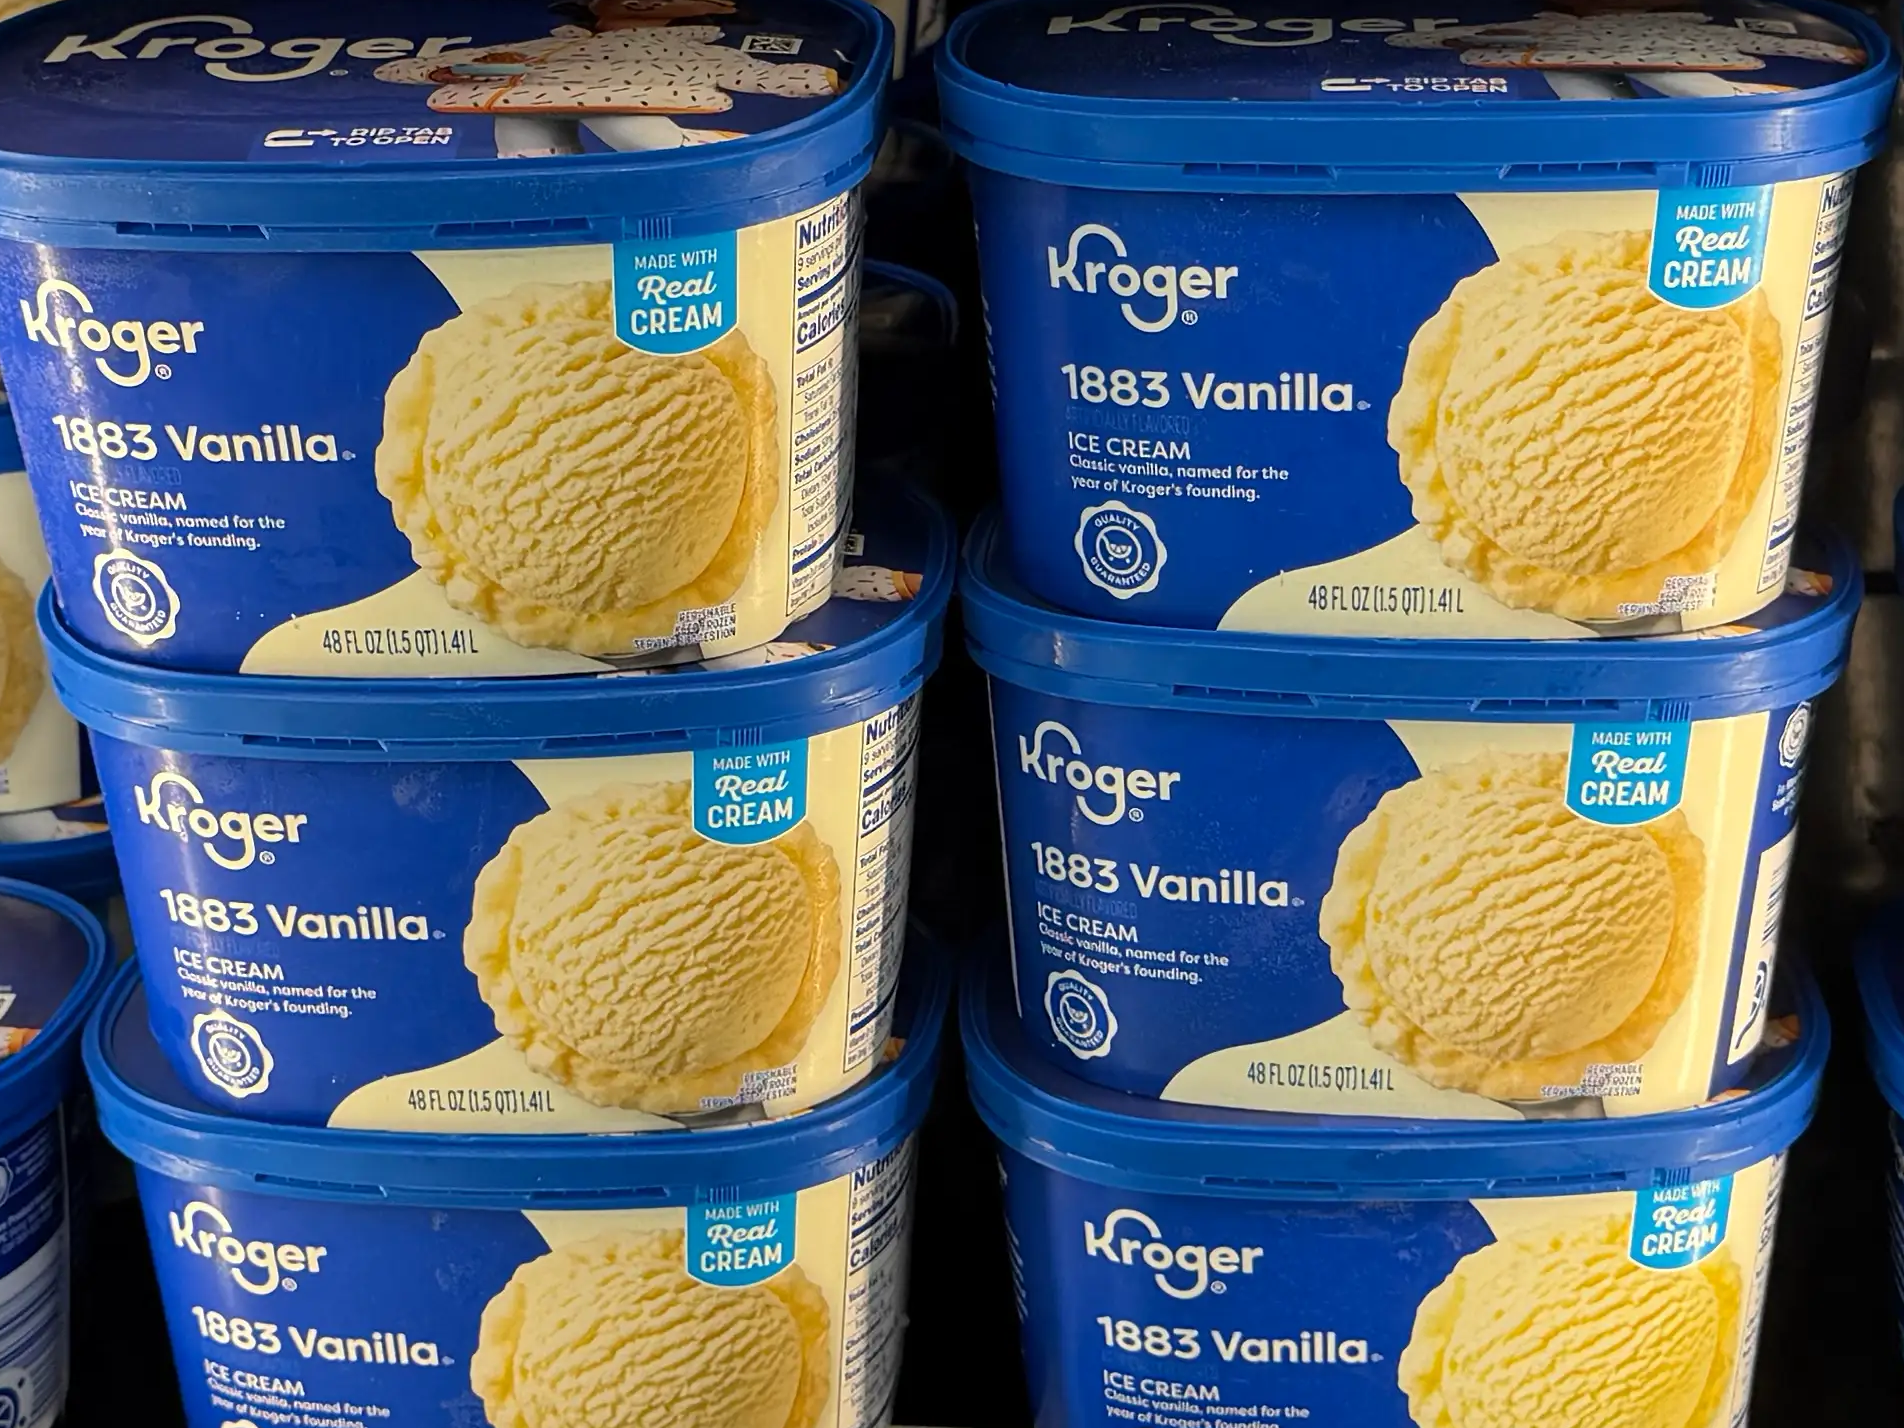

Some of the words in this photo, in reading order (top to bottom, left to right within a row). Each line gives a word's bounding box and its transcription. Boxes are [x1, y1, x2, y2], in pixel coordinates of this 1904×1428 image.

[637, 273, 717, 305] Real
[1048, 223, 1238, 333] Kroger
[20, 277, 204, 387] Kroger
[630, 303, 723, 335] CREAM
[1061, 363, 1169, 406] 1883
[1178, 370, 1353, 414] Vanilla
[52, 414, 157, 460] 1883
[165, 422, 340, 463] Vanilla
[1021, 720, 1180, 827] Kroger
[136, 771, 307, 870] Kroger
[160, 888, 258, 935] 1883
[267, 903, 429, 943] Vanilla
